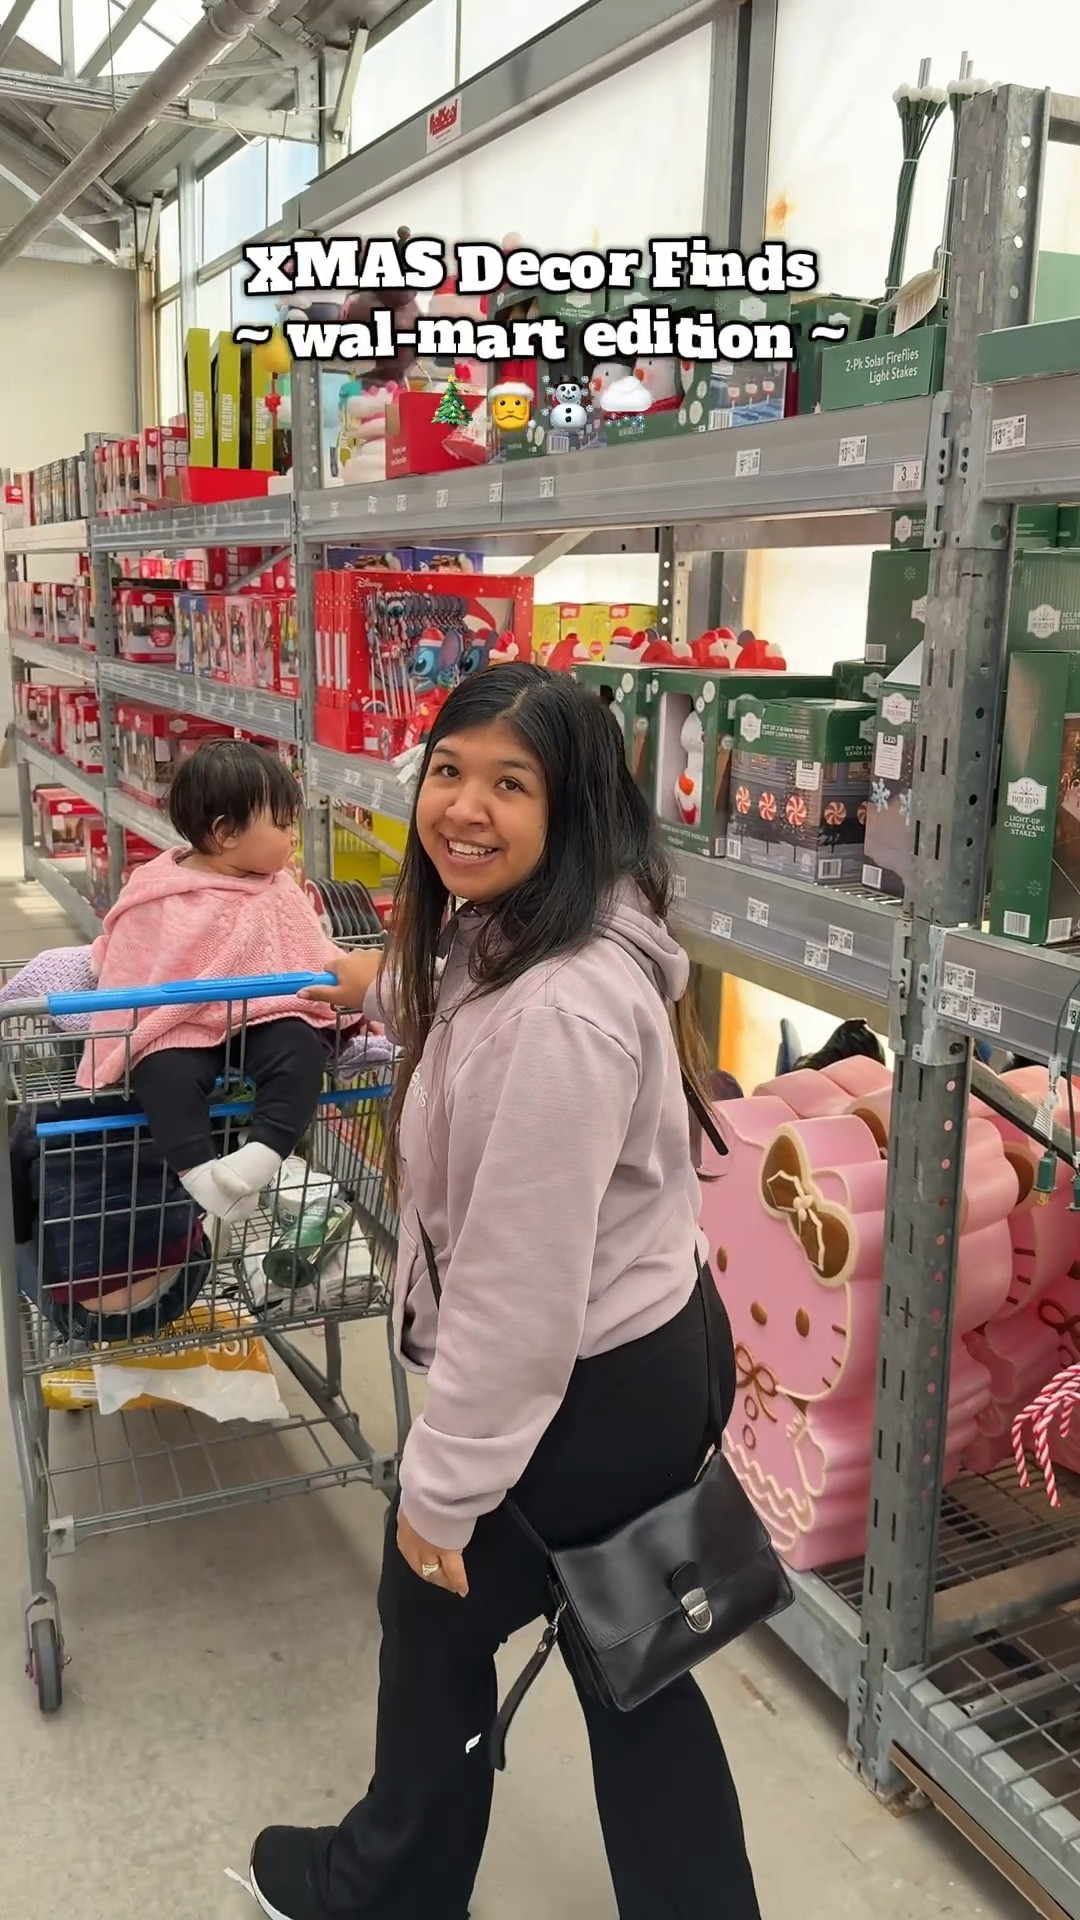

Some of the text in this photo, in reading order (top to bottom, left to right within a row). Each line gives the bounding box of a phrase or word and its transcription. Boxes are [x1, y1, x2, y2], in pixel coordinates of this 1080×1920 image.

[845, 348, 919, 372] 2-Pk Solar Fireflies
[869, 366, 918, 386] Light Stakes
[1003, 820, 1046, 832] CANDY CANE
[1009, 815, 1041, 825] LIGHT-UP
[1010, 829, 1038, 838] STAKES
